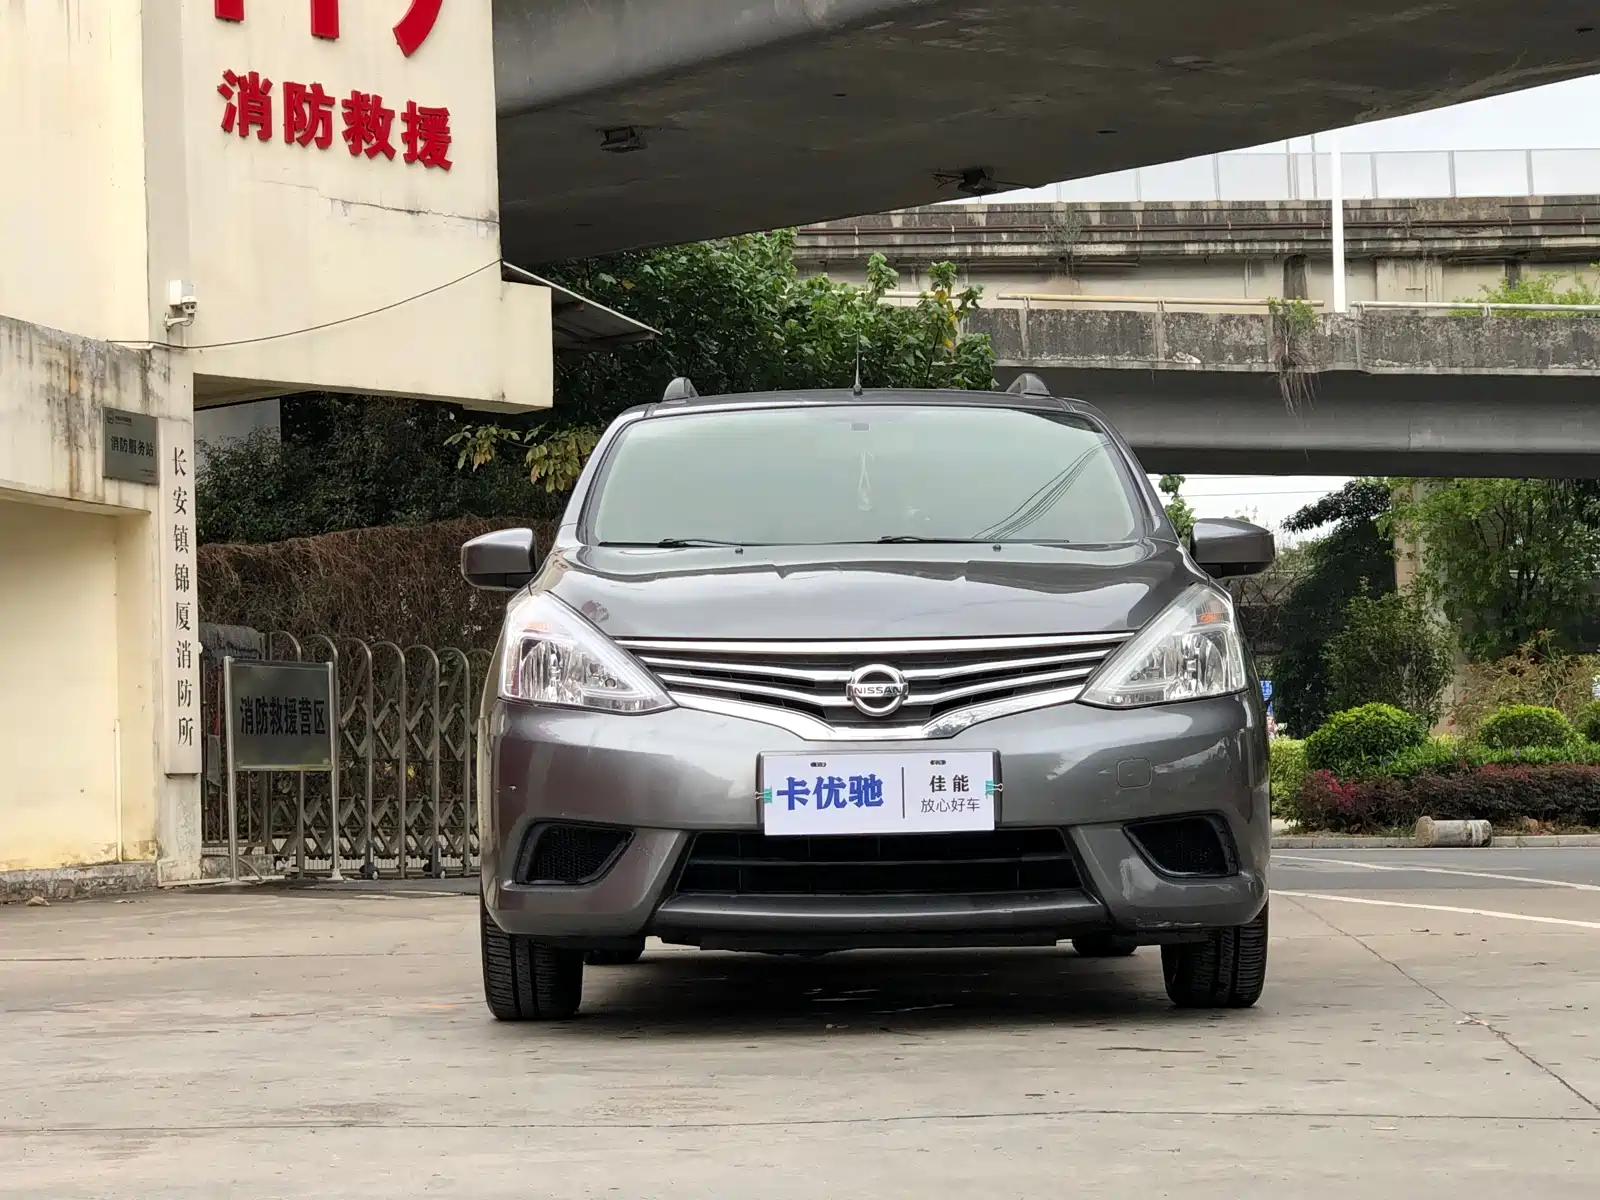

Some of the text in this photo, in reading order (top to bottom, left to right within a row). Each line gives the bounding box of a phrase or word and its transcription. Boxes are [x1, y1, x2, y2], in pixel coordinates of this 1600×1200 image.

[217, 69, 453, 171] 消防救援
[110, 435, 154, 457] 消防服务站
[172, 446, 194, 747] 长安镇锦厦消防所
[853, 686, 903, 696] NISSAN
[239, 696, 327, 736] 消防救援营区
[776, 773, 884, 811] 卡优驰
[920, 797, 981, 813] 放心好车
